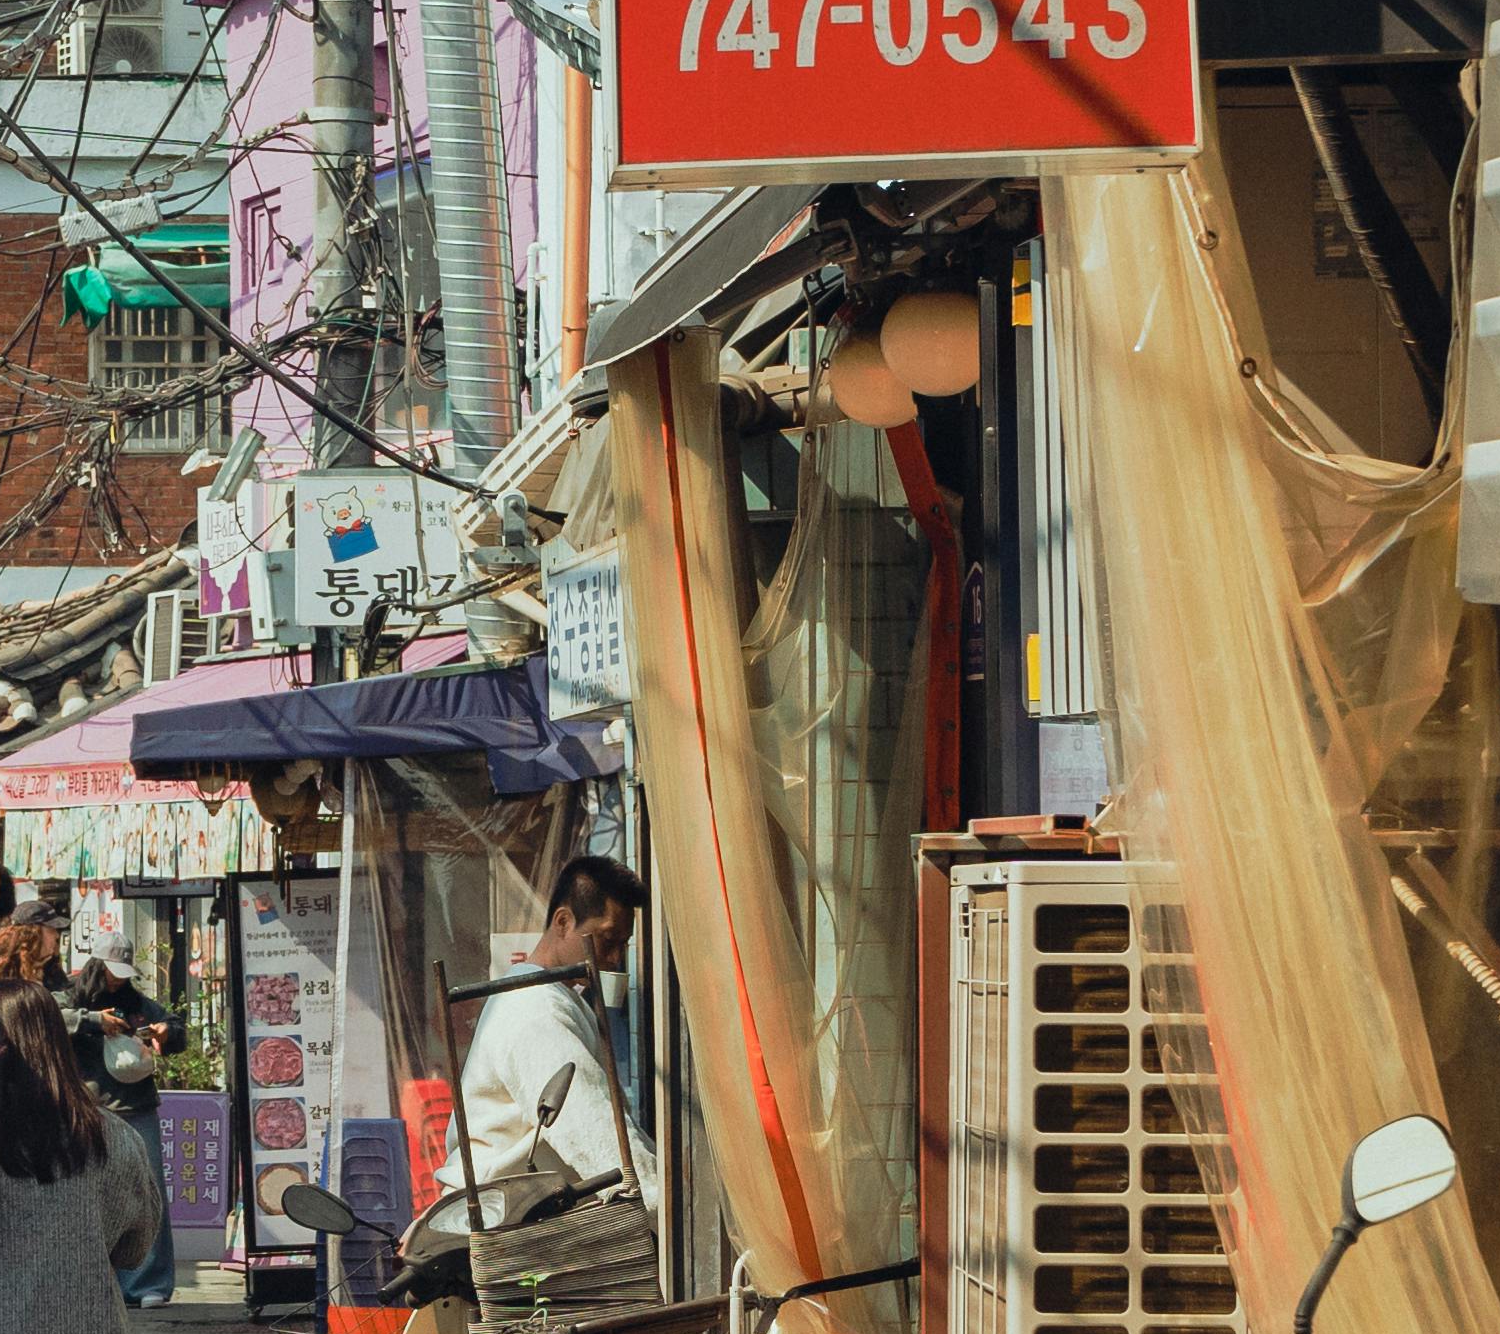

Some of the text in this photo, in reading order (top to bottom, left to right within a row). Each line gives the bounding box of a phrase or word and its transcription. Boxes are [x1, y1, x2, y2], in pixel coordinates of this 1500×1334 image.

[293, 894, 332, 917] 통돼
[303, 979, 335, 996] 삼겹
[179, 1117, 198, 1205] 취업운세
[202, 1118, 220, 1205] 재물운세
